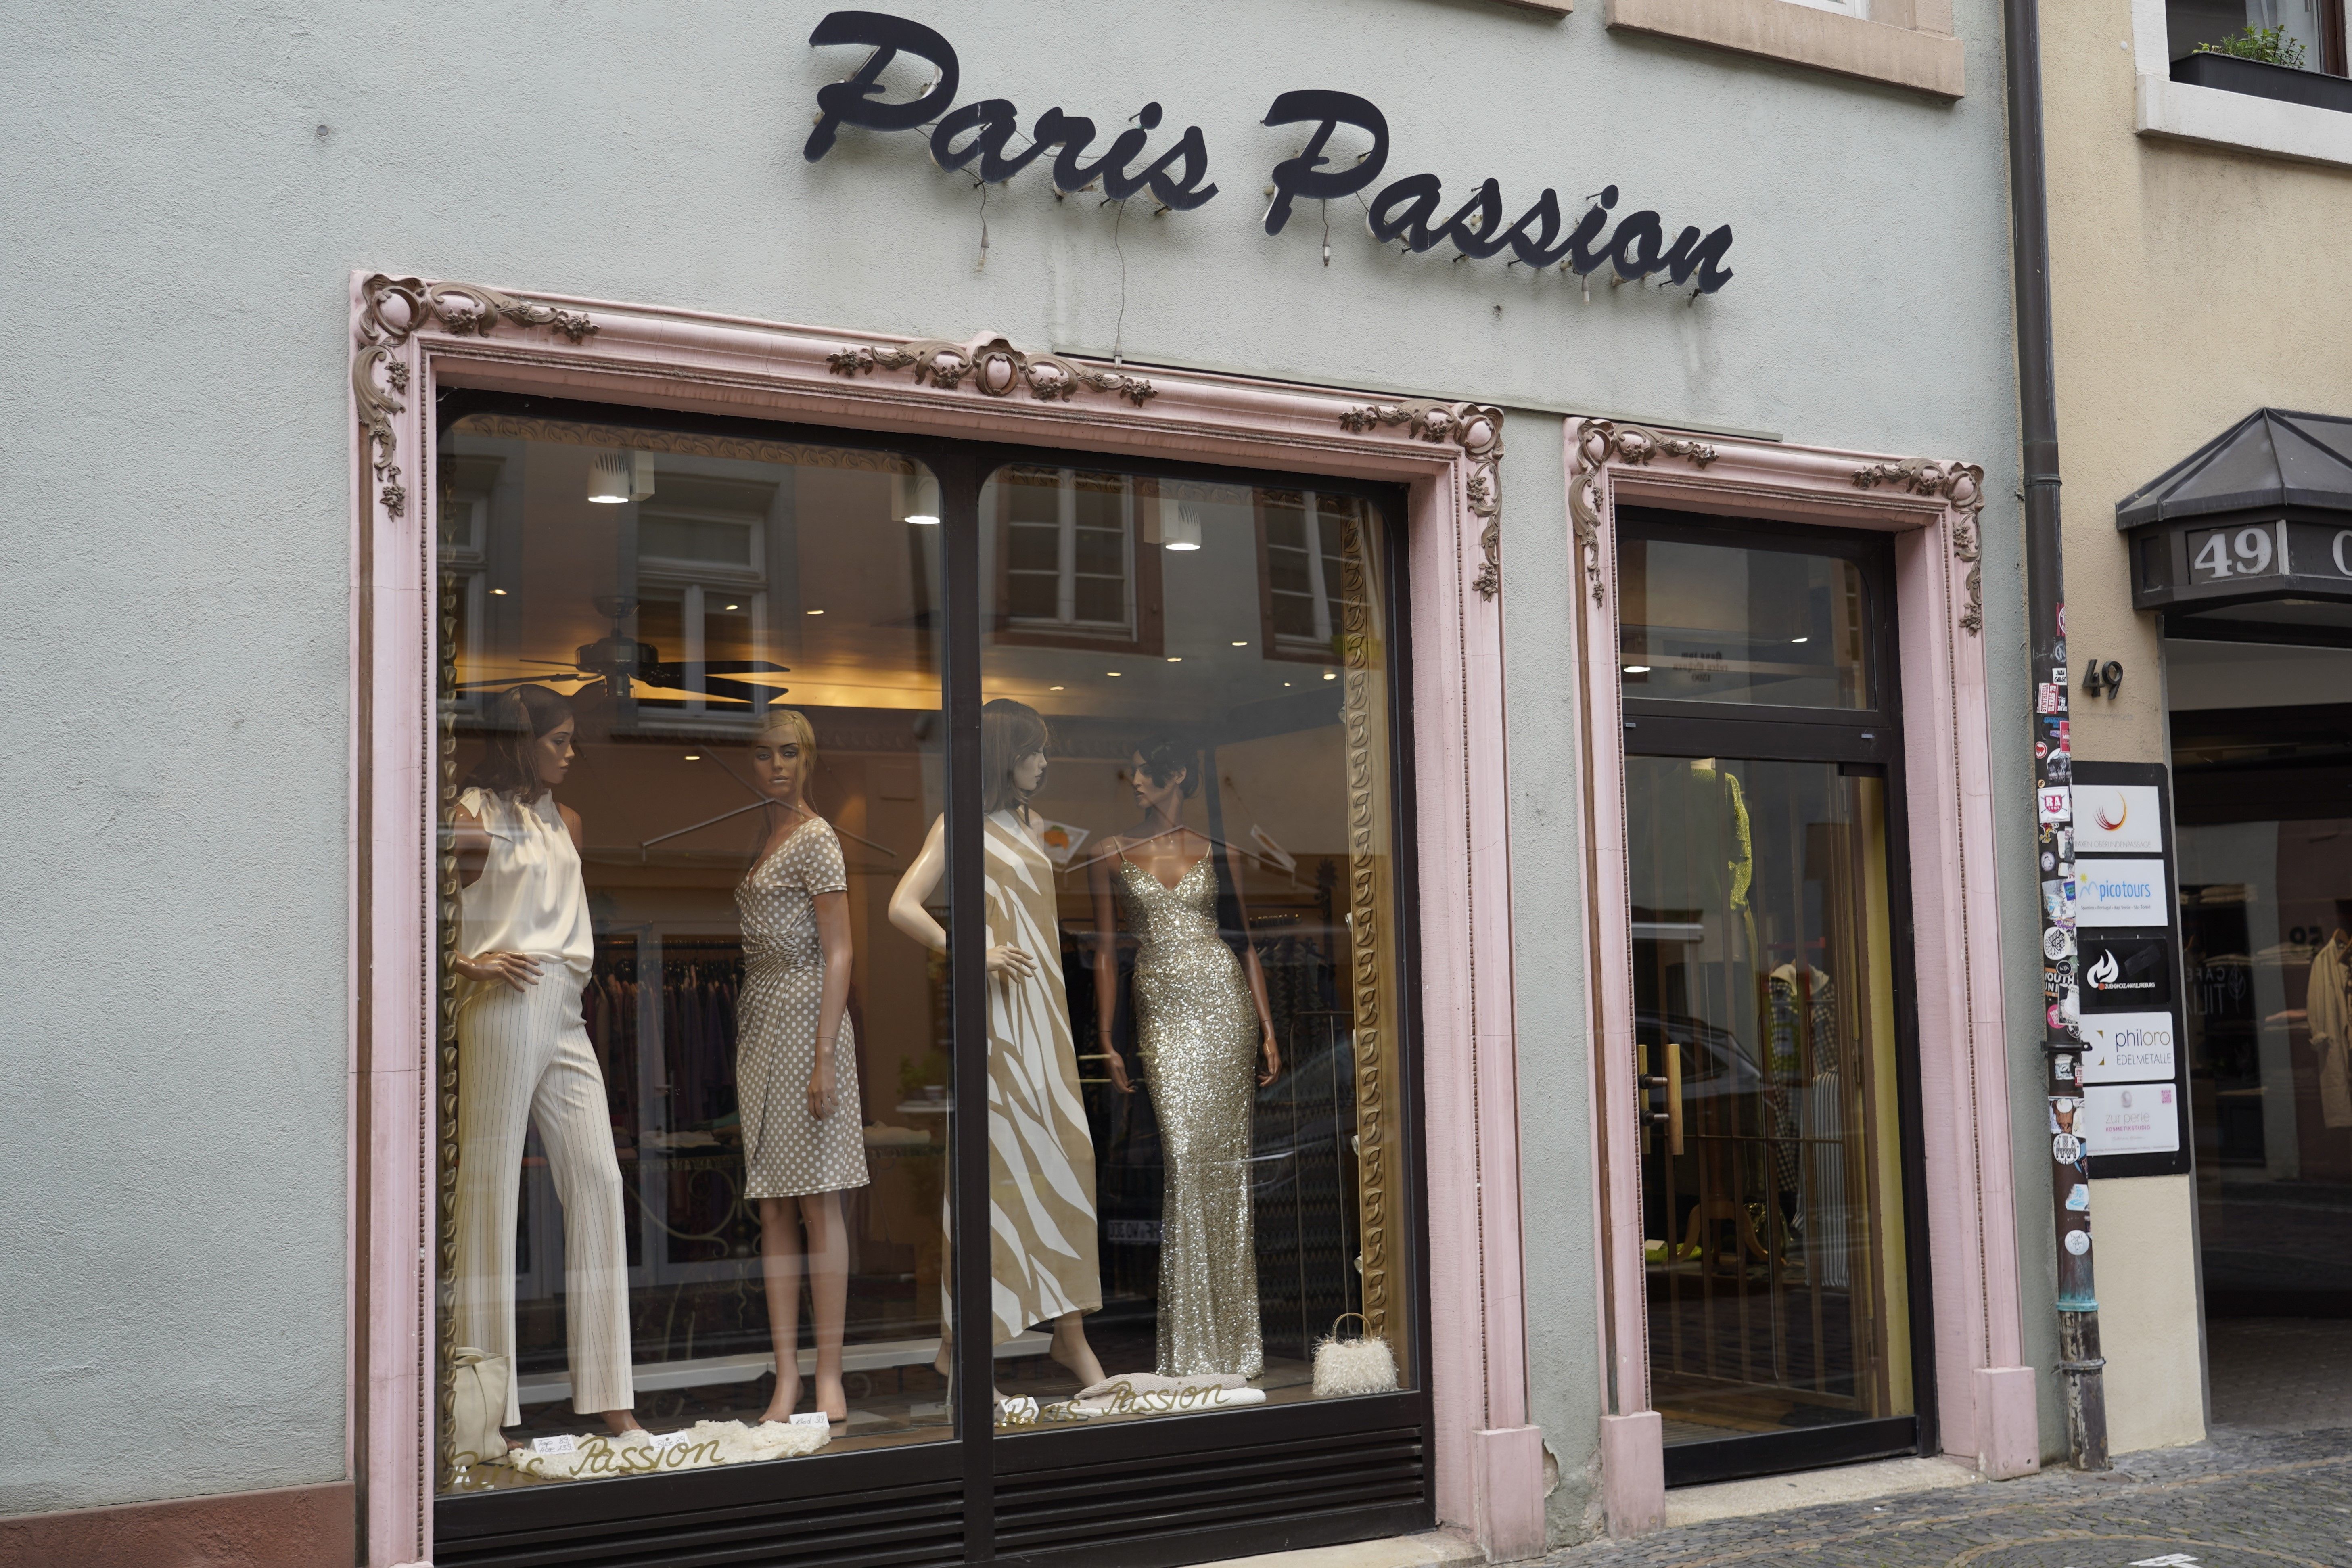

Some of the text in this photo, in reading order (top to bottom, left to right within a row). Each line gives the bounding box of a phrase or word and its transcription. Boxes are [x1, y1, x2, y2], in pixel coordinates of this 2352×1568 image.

[803, 11, 1733, 294] Paris Passion
[2194, 528, 2272, 578] 49
[2082, 659, 2124, 700] 49
[2045, 972, 2074, 984] YOUTH
[2116, 1029, 2170, 1052] philoro
[2117, 1053, 2172, 1066] EDELMETALLE
[2105, 1112, 2150, 1125] zur perle
[998, 1380, 1229, 1429] Paris Passion
[538, 1438, 553, 1448] Top
[655, 1439, 673, 1448] Bluse
[438, 1435, 725, 1492] Paris Passion
